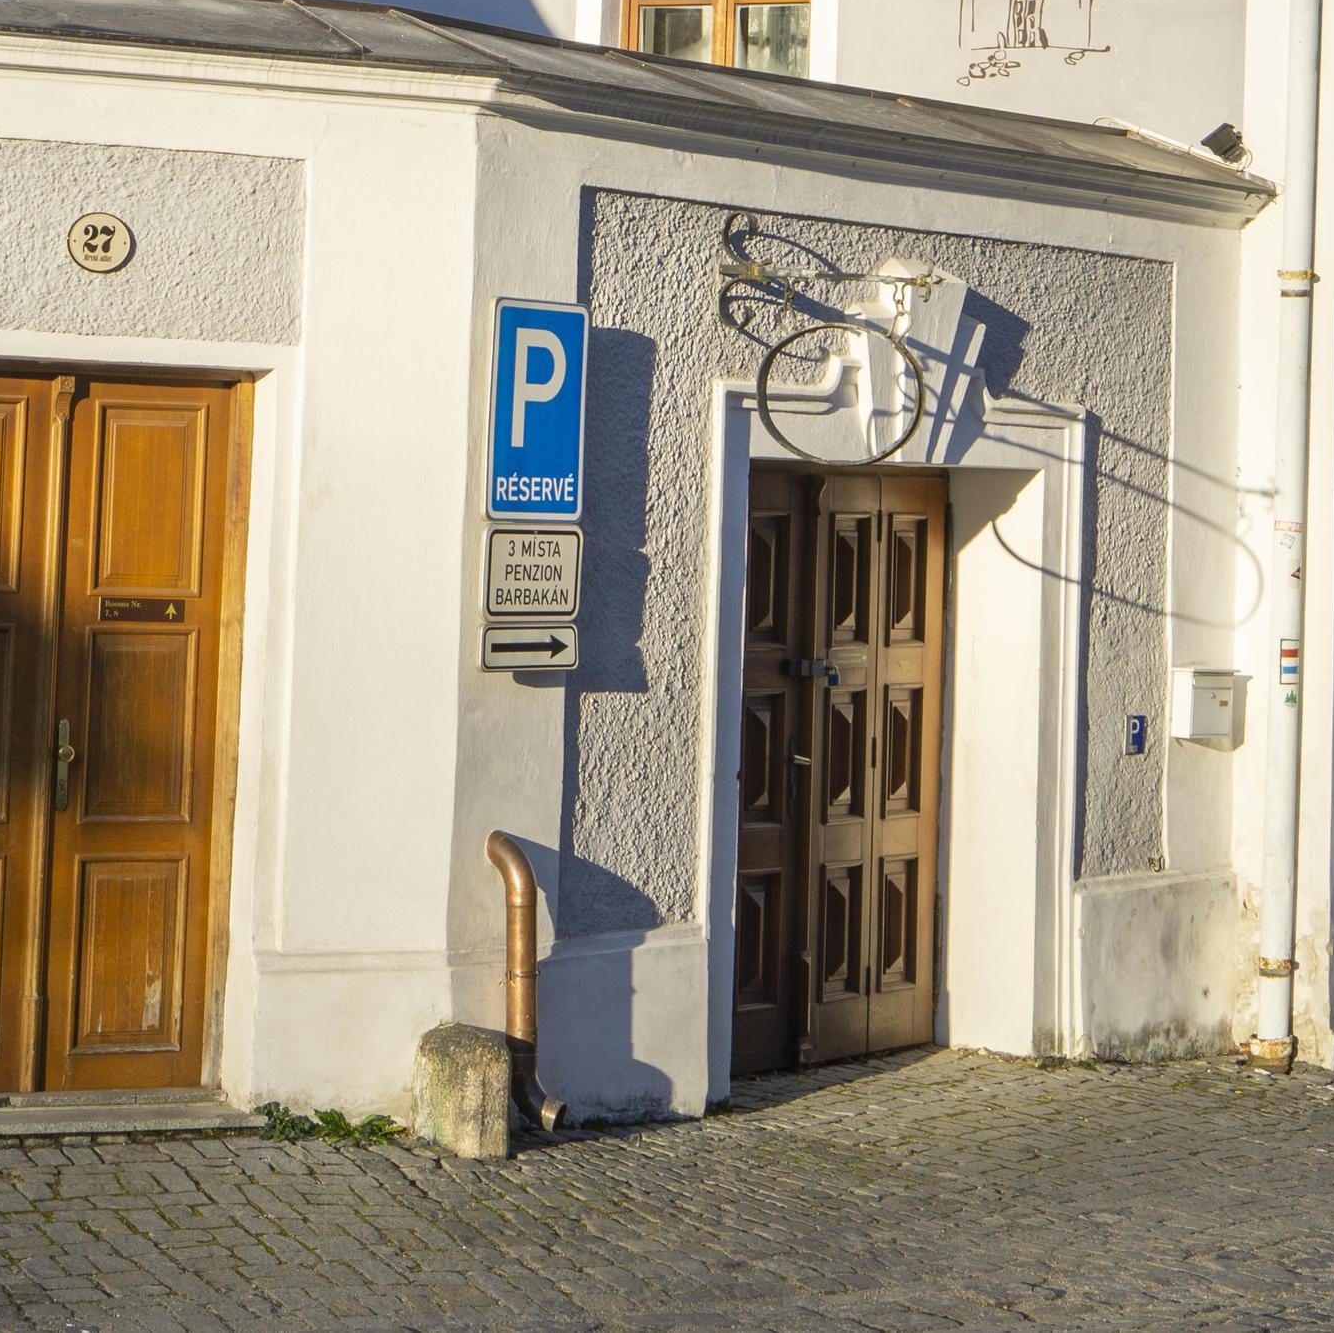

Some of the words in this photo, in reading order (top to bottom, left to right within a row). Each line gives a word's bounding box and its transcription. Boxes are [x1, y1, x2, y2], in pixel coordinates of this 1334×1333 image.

[82, 224, 116, 253] 27
[511, 327, 567, 447] P
[496, 472, 575, 503] RÉSERVÉ
[508, 540, 516, 557] 3
[521, 535, 561, 558] MÍSTA
[505, 564, 563, 582] PENZION
[105, 599, 130, 608] Rooms
[495, 584, 569, 606] BARBAKÁN
[1129, 718, 1140, 744] P
